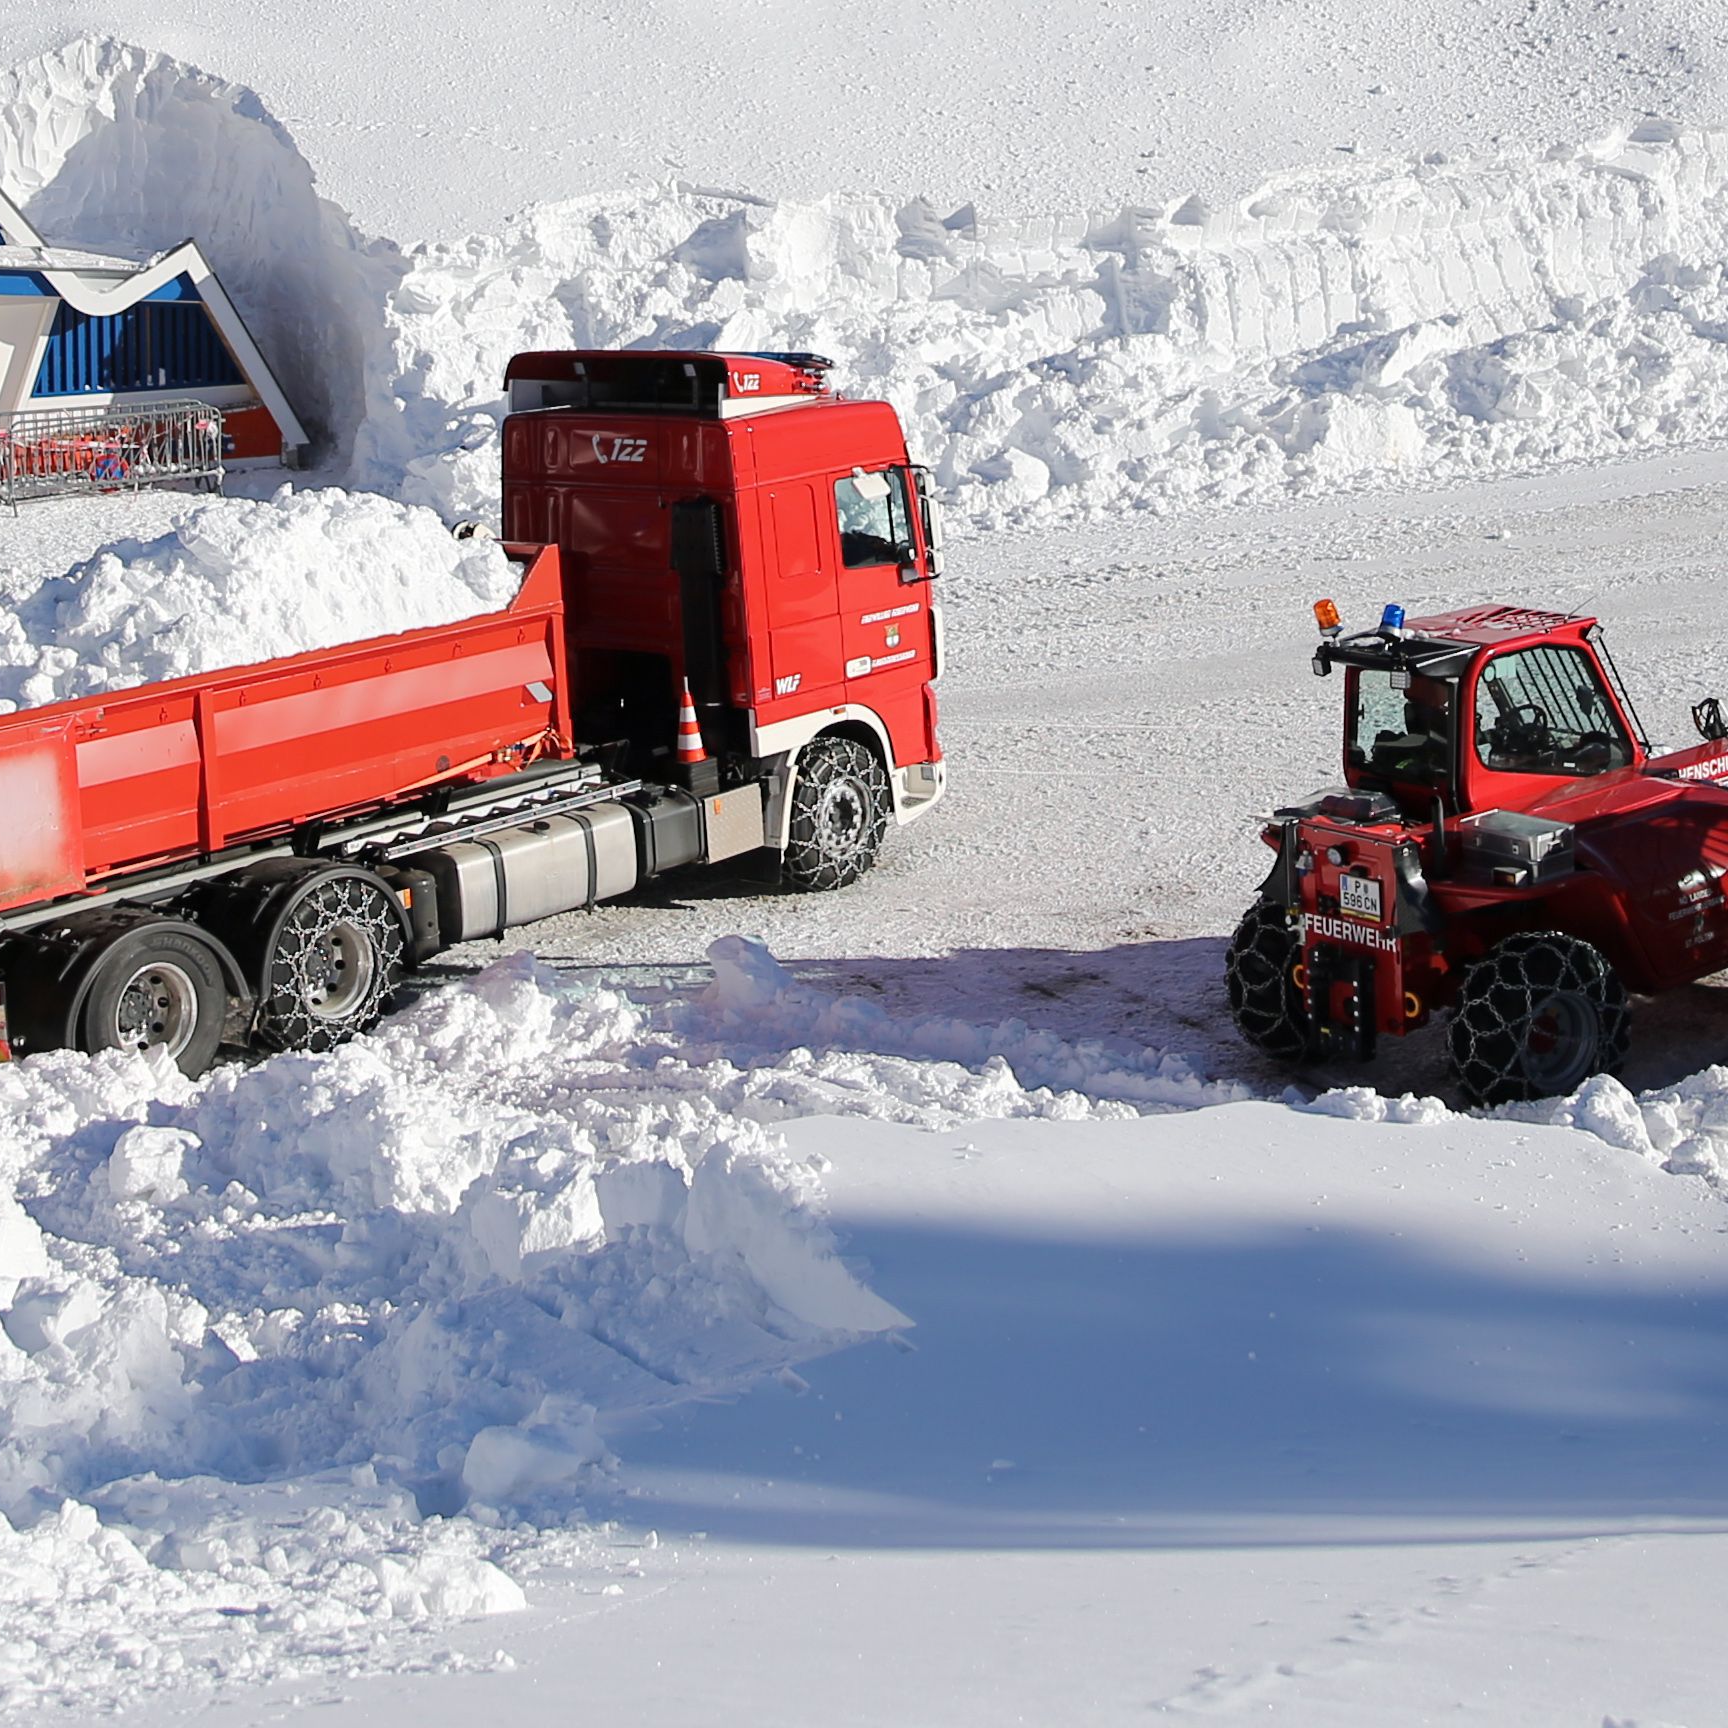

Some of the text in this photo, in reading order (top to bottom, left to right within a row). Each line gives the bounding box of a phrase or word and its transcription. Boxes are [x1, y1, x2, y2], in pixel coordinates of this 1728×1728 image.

[743, 374, 760, 390] 122
[610, 438, 648, 462] 122
[1305, 913, 1397, 953] FEUERWEHR
